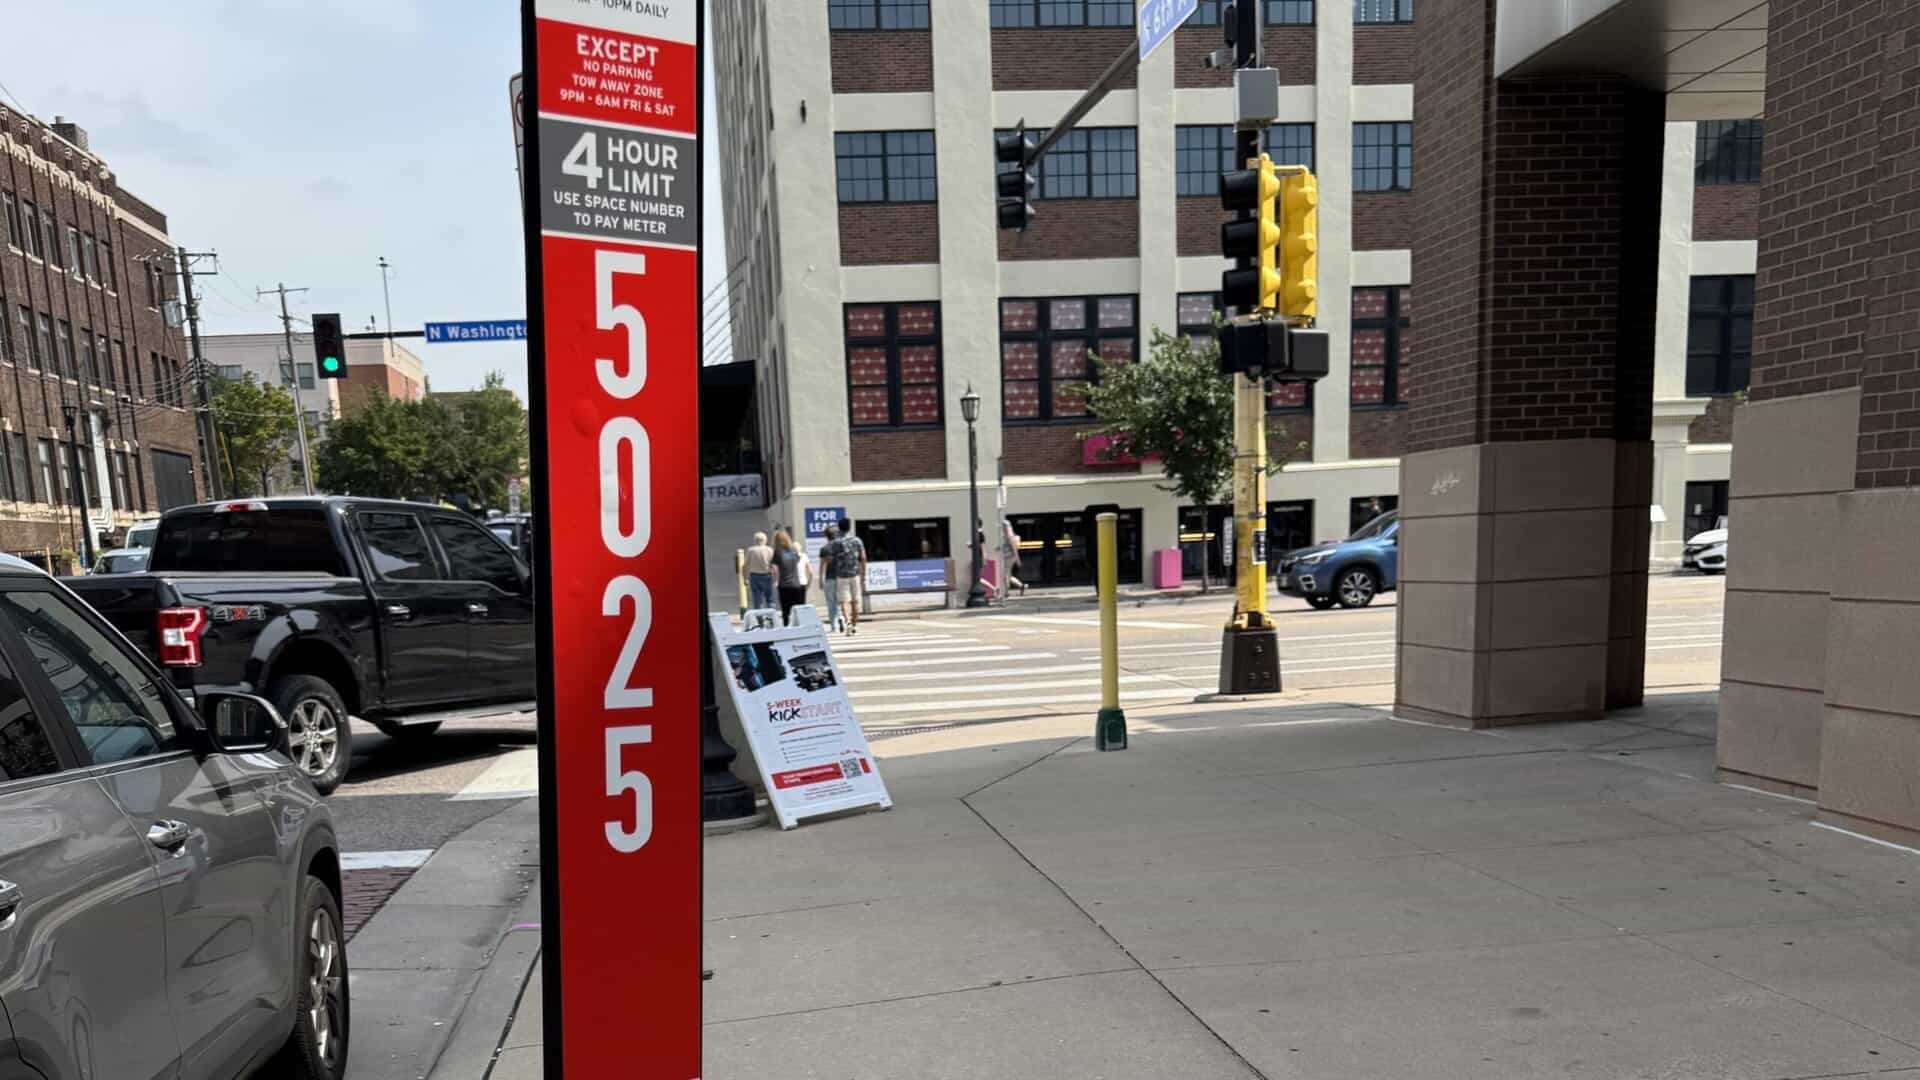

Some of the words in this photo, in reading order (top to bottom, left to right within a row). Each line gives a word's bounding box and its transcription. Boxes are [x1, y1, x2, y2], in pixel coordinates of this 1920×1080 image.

[636, 1, 670, 18] DAILY
[576, 33, 659, 67] EXCEPT
[583, 59, 600, 72] NO
[602, 62, 653, 81] PARKING
[572, 73, 597, 88] TOW
[600, 78, 631, 93] AWAY
[634, 84, 664, 99] ZONE
[560, 88, 585, 103] 9PM
[595, 94, 620, 108] 6AM
[623, 98, 641, 112] FRI
[644, 101, 652, 113] &
[655, 103, 675, 117] SAT
[561, 131, 603, 189] 4
[607, 136, 678, 169] HOUR
[608, 167, 675, 198] LIMIT
[553, 190, 581, 206] USE
[584, 194, 627, 211] SPACE
[630, 200, 685, 219] NUMBER
[574, 212, 591, 226] TO
[595, 214, 620, 229] PAY
[623, 218, 666, 235] METER
[429, 326, 441, 339] N
[704, 484, 760, 498] TRACK
[814, 511, 837, 520] FOR
[809, 522, 840, 533] LEA
